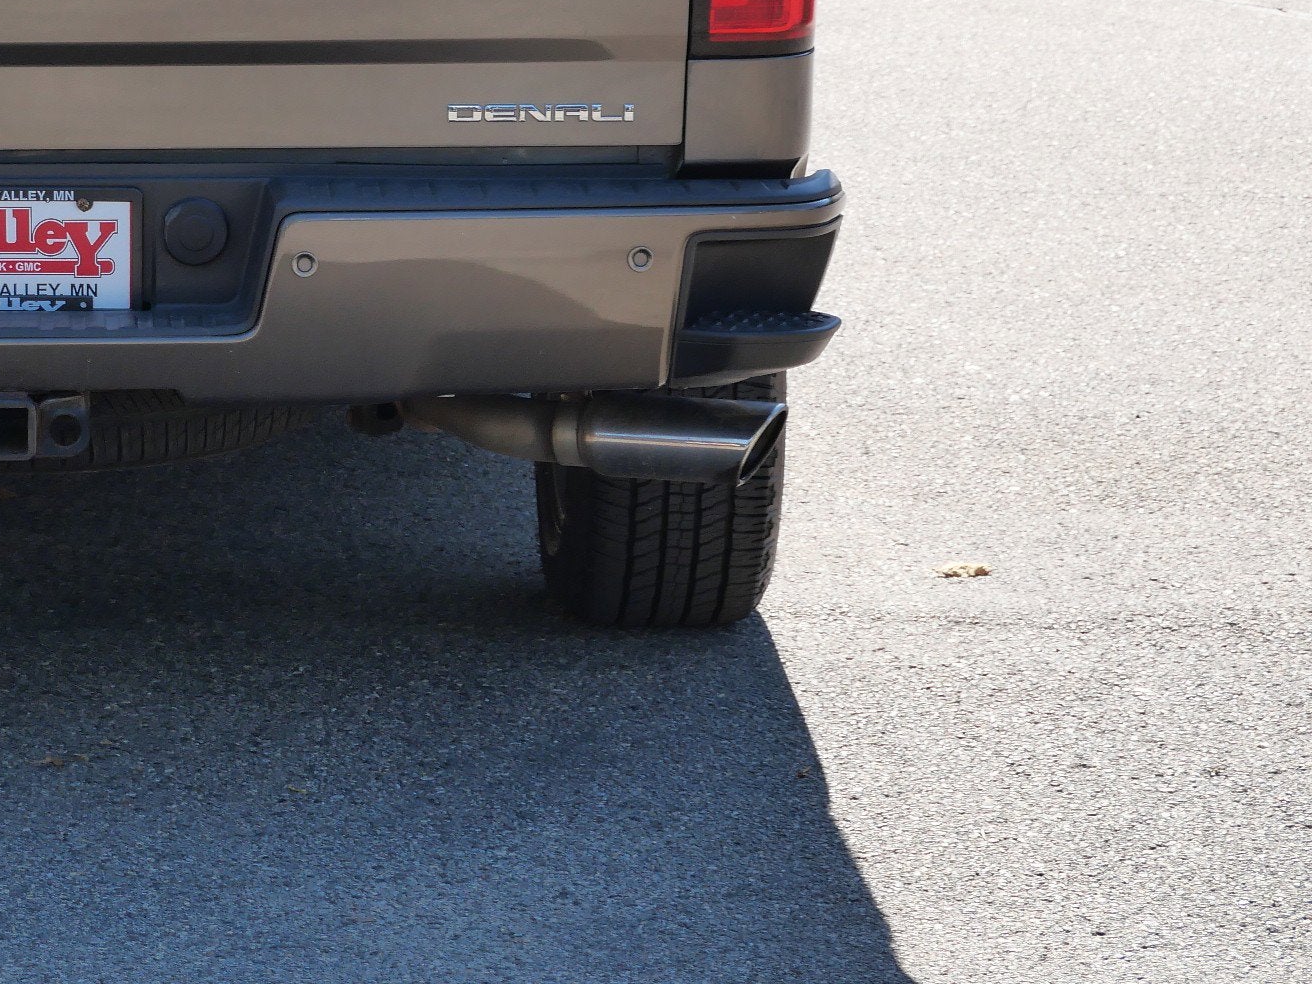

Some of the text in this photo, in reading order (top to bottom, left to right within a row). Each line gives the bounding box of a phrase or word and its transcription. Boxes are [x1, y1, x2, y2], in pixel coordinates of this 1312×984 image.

[447, 103, 635, 122] DENALI
[53, 190, 75, 201] MN
[15, 262, 42, 272] GMC
[70, 283, 99, 298] MN
